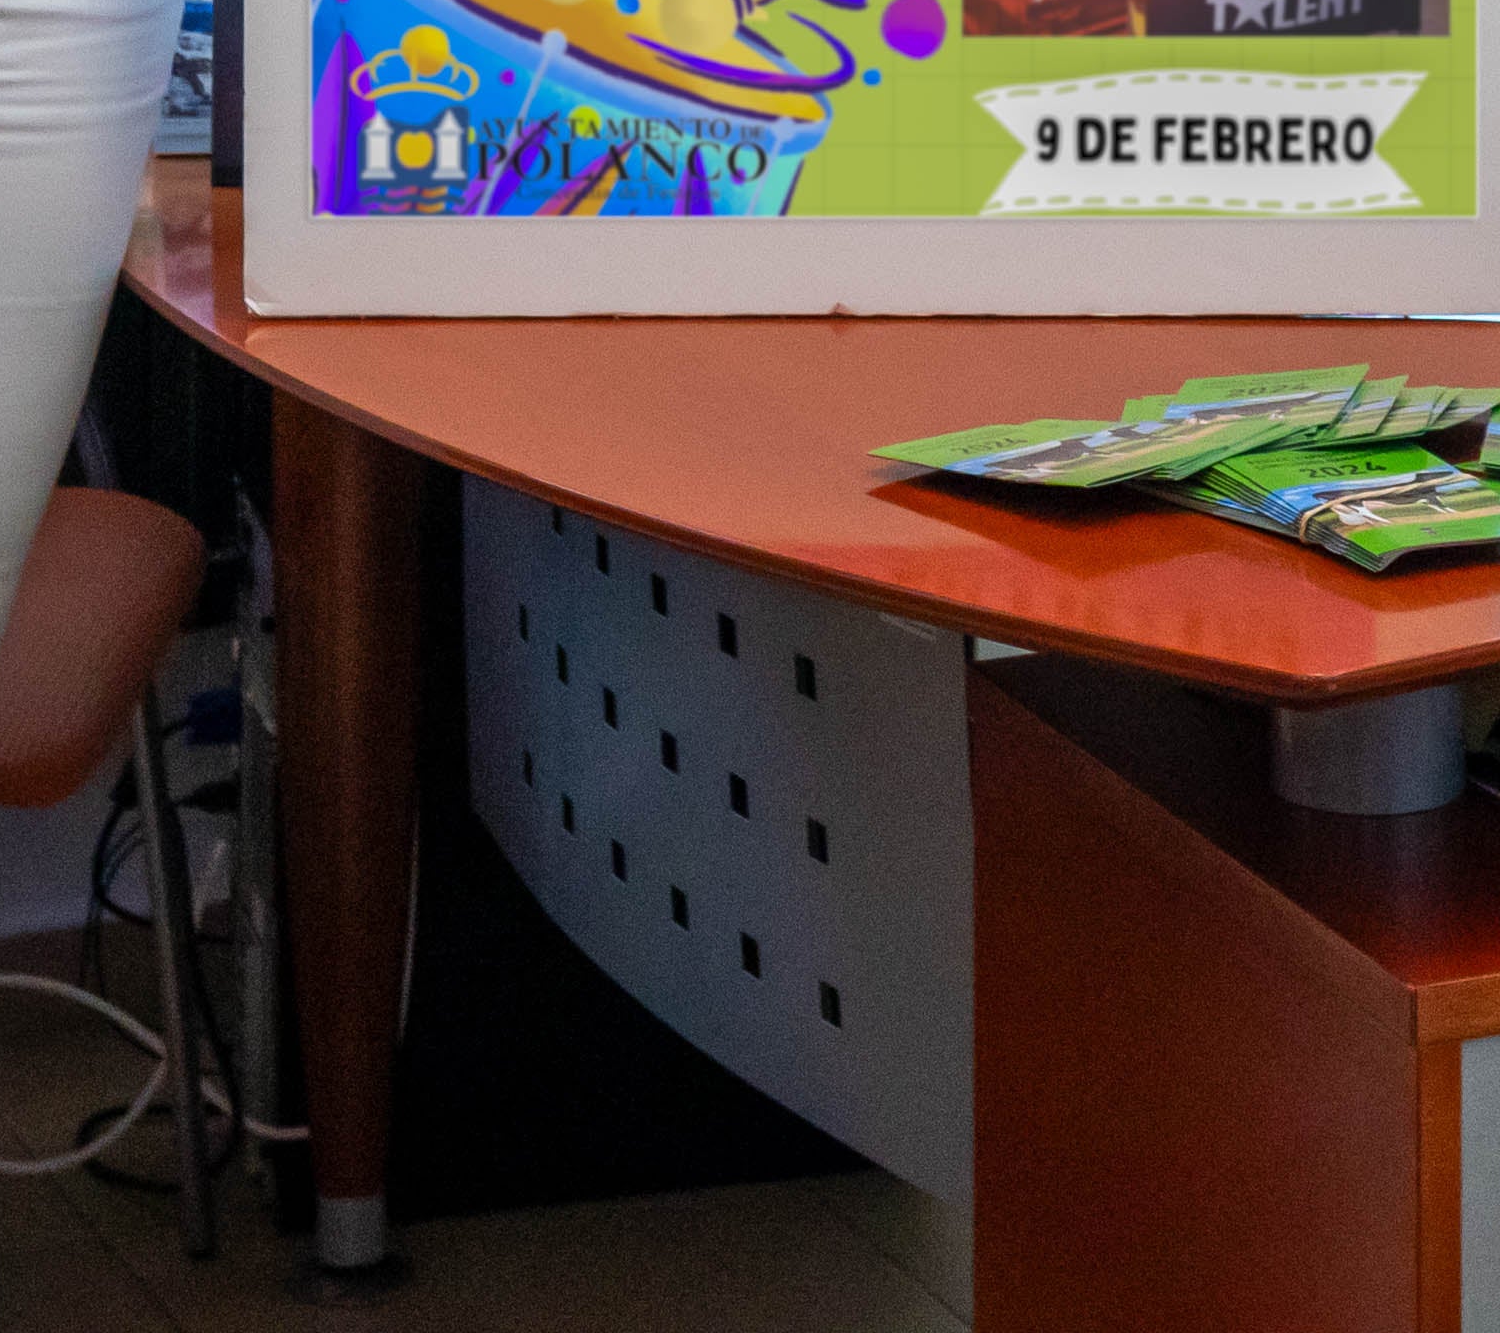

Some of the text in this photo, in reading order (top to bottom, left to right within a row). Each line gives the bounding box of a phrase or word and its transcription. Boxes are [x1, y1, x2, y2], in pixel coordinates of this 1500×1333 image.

[1036, 115, 1376, 164] 9 DE FEBRERO
[477, 140, 768, 183] POLANCO
[1299, 460, 1388, 480] 2024
